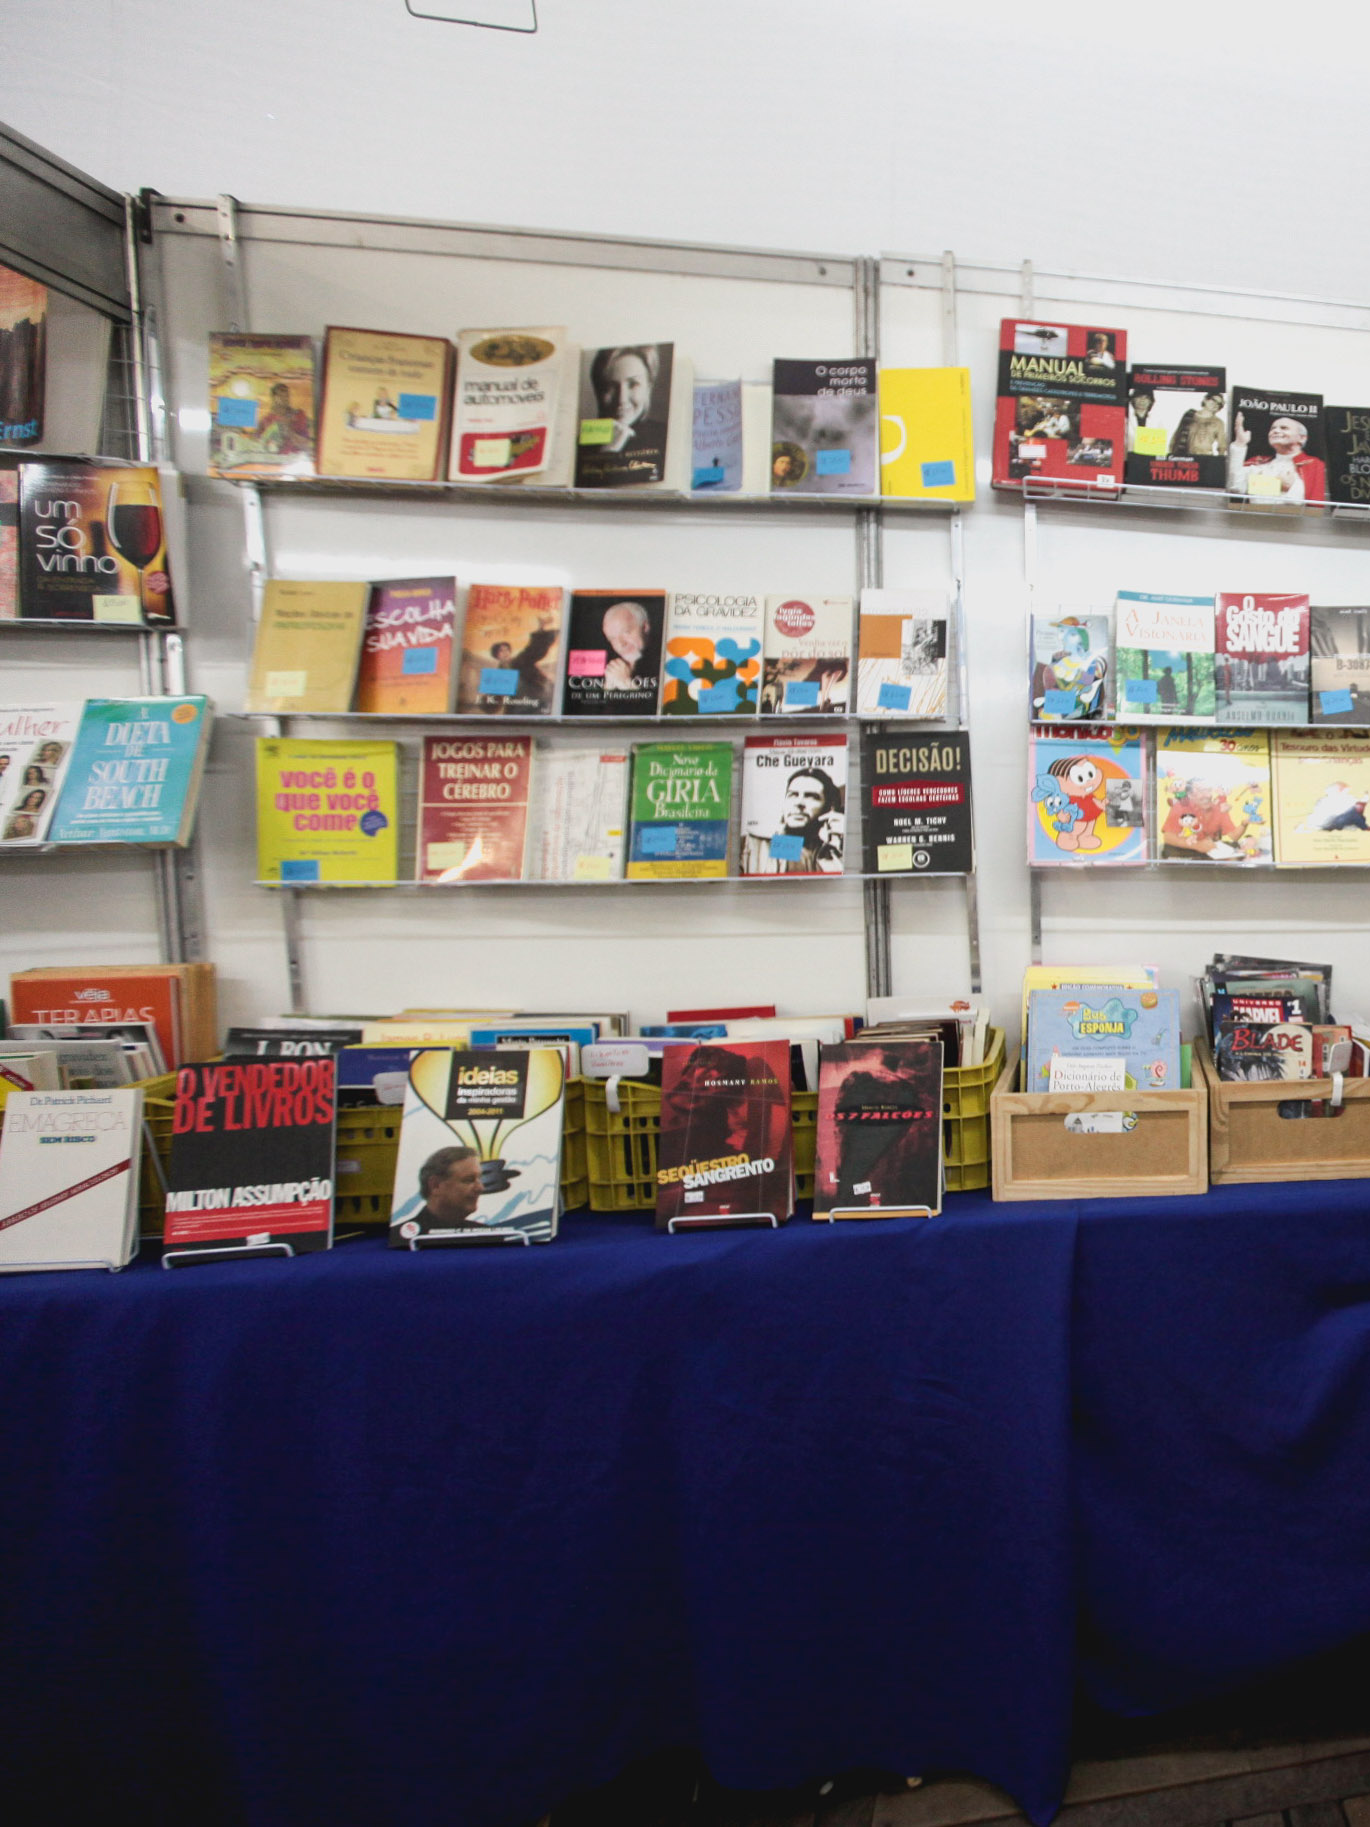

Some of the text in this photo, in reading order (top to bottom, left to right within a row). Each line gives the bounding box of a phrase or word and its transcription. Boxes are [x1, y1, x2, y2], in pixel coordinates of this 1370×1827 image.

[815, 364, 867, 378] O corpo
[1010, 355, 1086, 377] MANUAL
[829, 376, 867, 387] morto
[836, 386, 867, 397] deus
[1238, 397, 1318, 414] JOÃO PAULO II
[1150, 468, 1199, 482] THUMB
[34, 500, 82, 519] um
[36, 549, 119, 574] vinho
[674, 593, 757, 607] PSICOLOGIA
[1242, 596, 1255, 611] O
[674, 606, 758, 618] DA GRAVIDEZ
[1226, 606, 1275, 626] Gosto
[1226, 624, 1300, 652] SANGUE
[0, 716, 70, 737] ulher
[105, 721, 172, 746] DIETA
[431, 742, 525, 760] JOGOS PARA
[1219, 739, 1236, 751] 30
[1280, 742, 1320, 752] Tesouro
[1321, 742, 1339, 752] das
[672, 753, 700, 766] Novo
[756, 754, 835, 768] Che Guevara
[875, 742, 961, 774] DECISÃO!
[88, 758, 171, 784] SOUTH
[280, 767, 337, 789] você
[437, 762, 519, 779] TREINAR O
[83, 783, 163, 810] BEACH
[442, 779, 511, 800] CÉREBRO
[646, 777, 721, 804] GÍRIA
[274, 789, 379, 812] que você
[653, 802, 711, 819] Brasileira
[293, 813, 358, 832] come
[31, 1006, 155, 1023] TERAPIAS
[1080, 1022, 1124, 1034] ESPONJA
[1231, 1027, 1304, 1052] BLADE
[176, 1059, 335, 1099] O VENDEDOR
[457, 1066, 519, 1086] ideias
[1053, 1069, 1122, 1081] Dicionário de
[456, 1086, 518, 1098] inspiradoras
[1053, 1081, 1121, 1092] Porto-Alegrês
[172, 1088, 335, 1135] DE LIVROS
[39, 1135, 96, 1144] SEM RISCO
[657, 1153, 750, 1185] SEQÜESTRO
[682, 1158, 775, 1190] SANGRENTO
[165, 1178, 333, 1213] MILTON ASSUMPÇÃO
